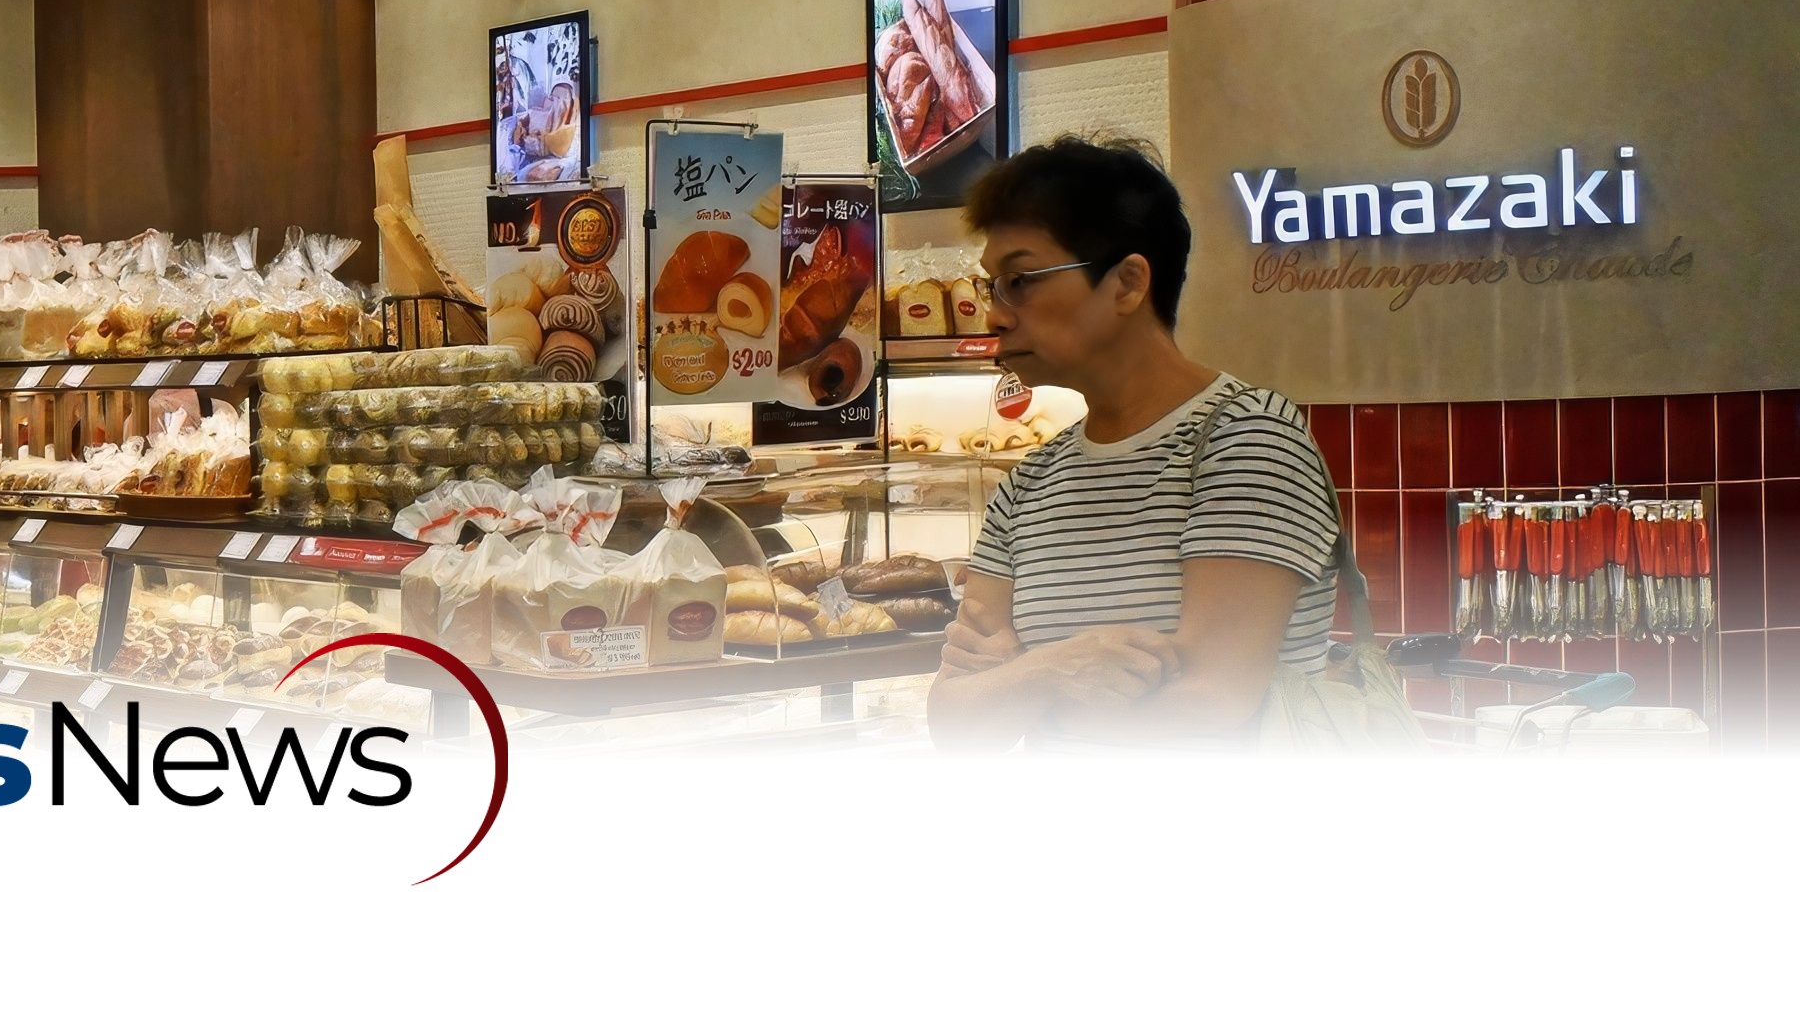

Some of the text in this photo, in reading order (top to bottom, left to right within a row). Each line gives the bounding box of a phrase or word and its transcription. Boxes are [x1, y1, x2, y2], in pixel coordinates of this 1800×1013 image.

[673, 155, 759, 203] 塩パン
[1232, 145, 1638, 244] Yamazaki
[1252, 247, 1509, 312] Boulangerie
[732, 347, 773, 377] $2.00
